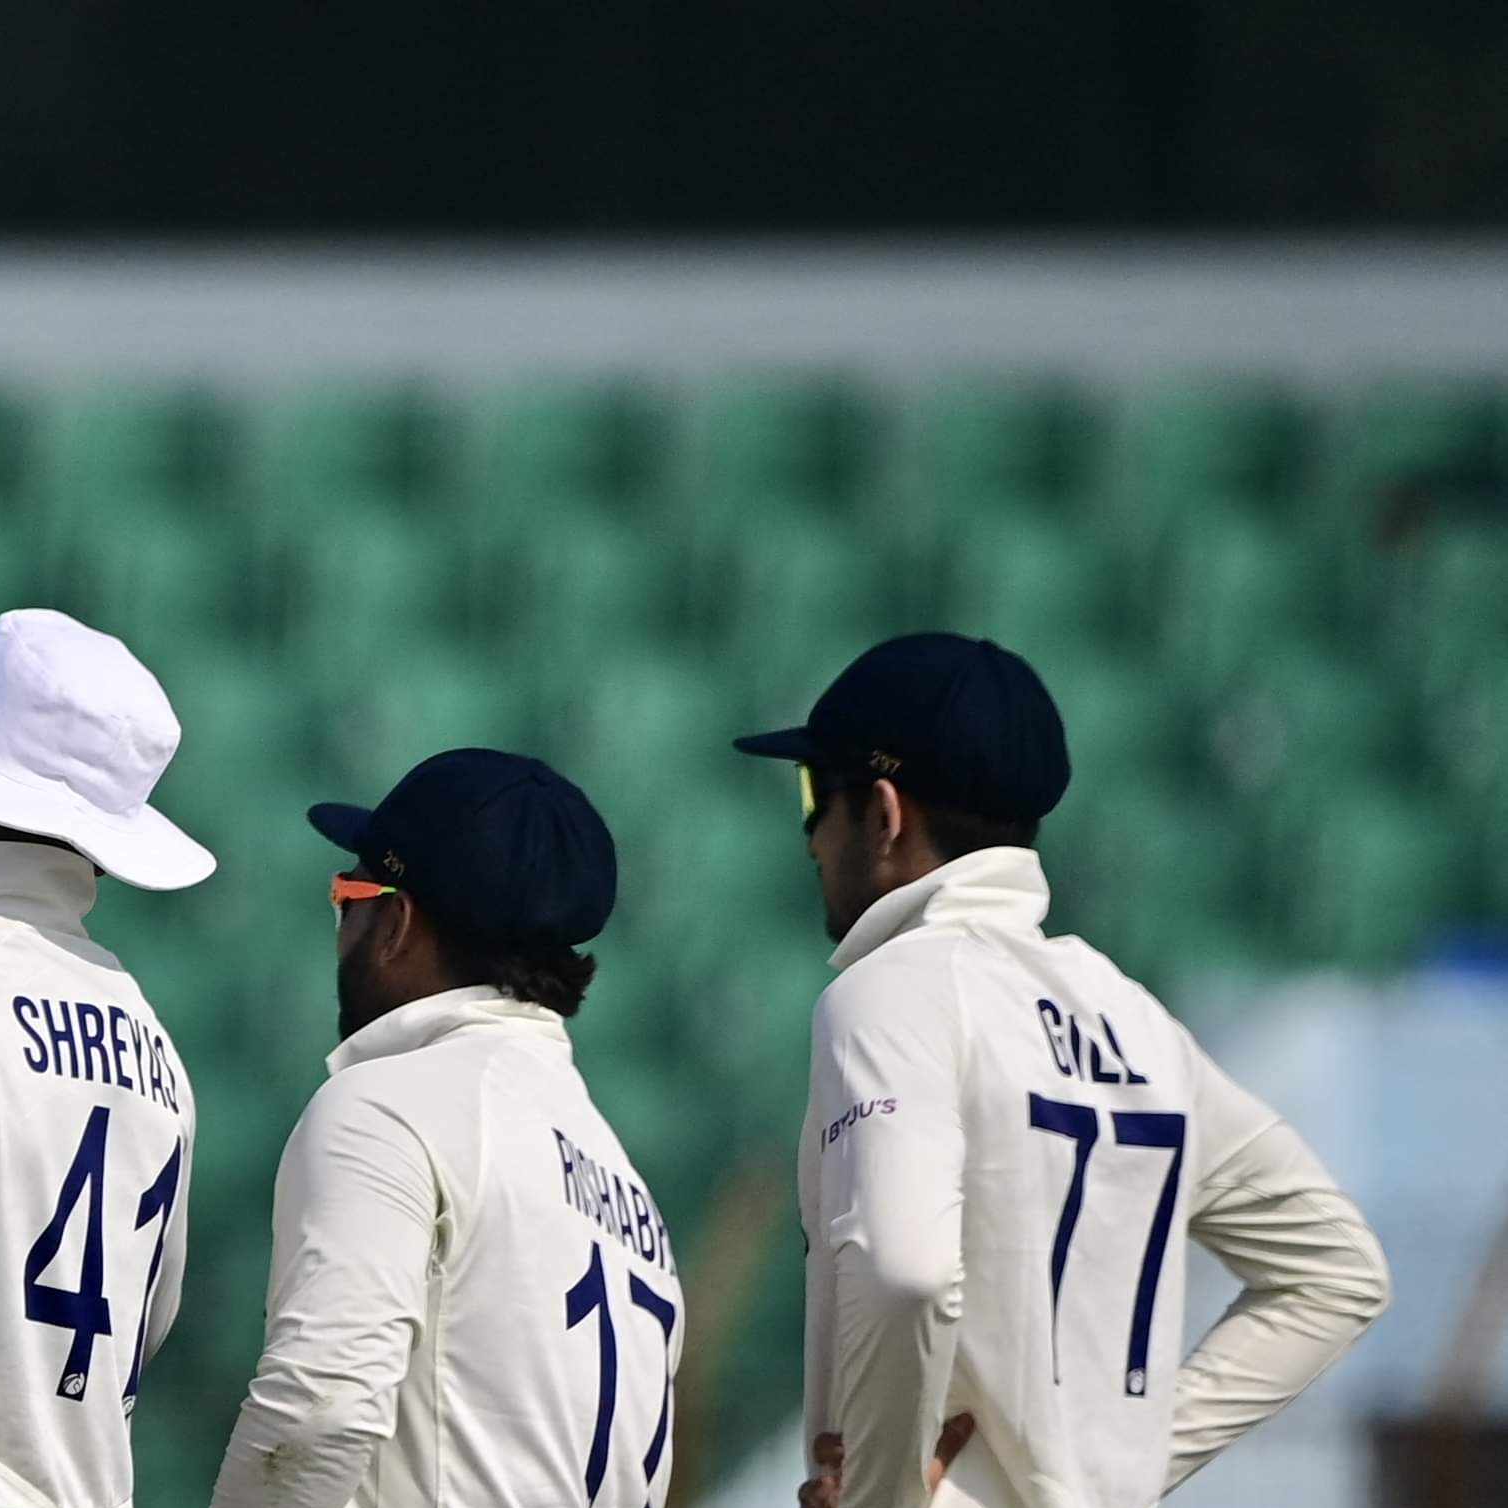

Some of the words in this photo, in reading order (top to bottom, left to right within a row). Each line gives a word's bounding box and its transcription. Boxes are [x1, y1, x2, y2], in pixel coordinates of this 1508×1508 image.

[12, 995, 180, 1115] SHREYAS
[1036, 998, 1149, 1085] GILL
[828, 1098, 898, 1145] BYJU'S
[24, 1105, 184, 1418] 41
[1027, 1091, 1189, 1398] 77
